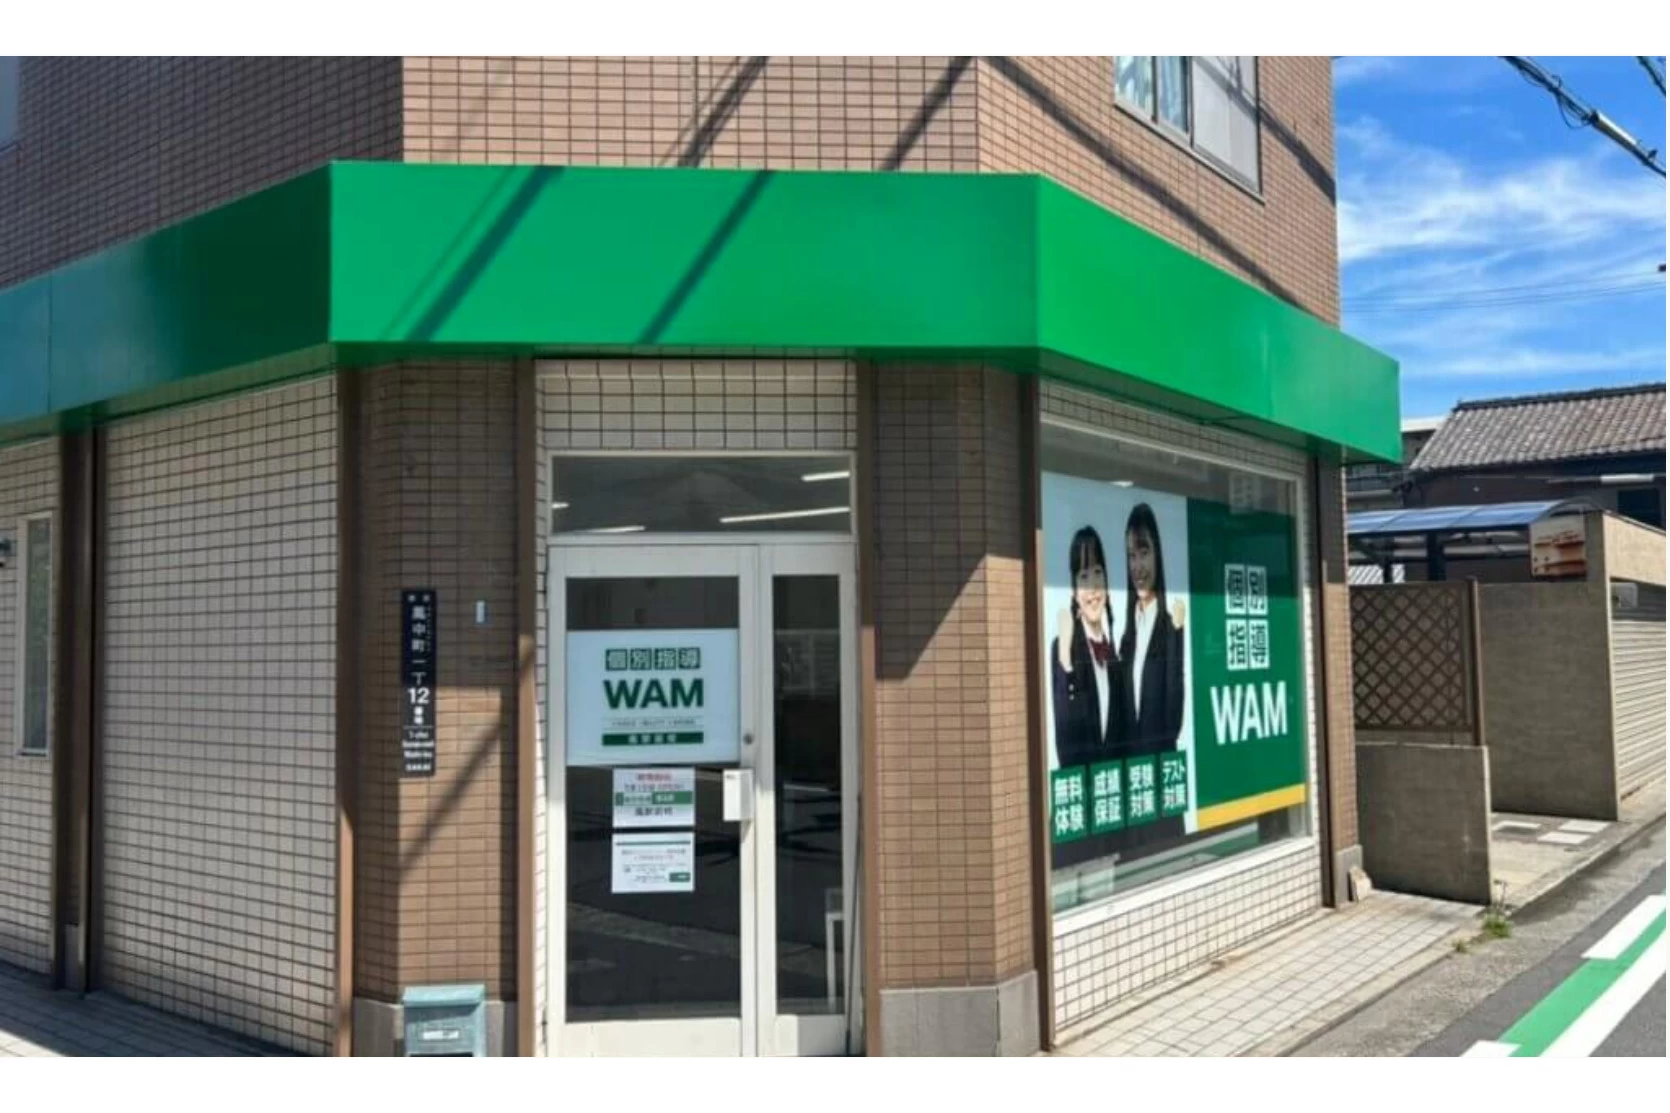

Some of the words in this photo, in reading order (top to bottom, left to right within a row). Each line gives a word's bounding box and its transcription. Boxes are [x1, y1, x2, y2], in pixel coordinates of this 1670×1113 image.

[605, 647, 701, 671] 個別指導
[1228, 619, 1269, 670] 指導
[408, 686, 430, 704] 12
[603, 678, 704, 710] WAM
[1210, 680, 1288, 746] WAM
[1129, 763, 1154, 790] 受験
[1162, 759, 1186, 784] テスト
[1055, 773, 1082, 806] 無料
[1055, 803, 1084, 836] 体験
